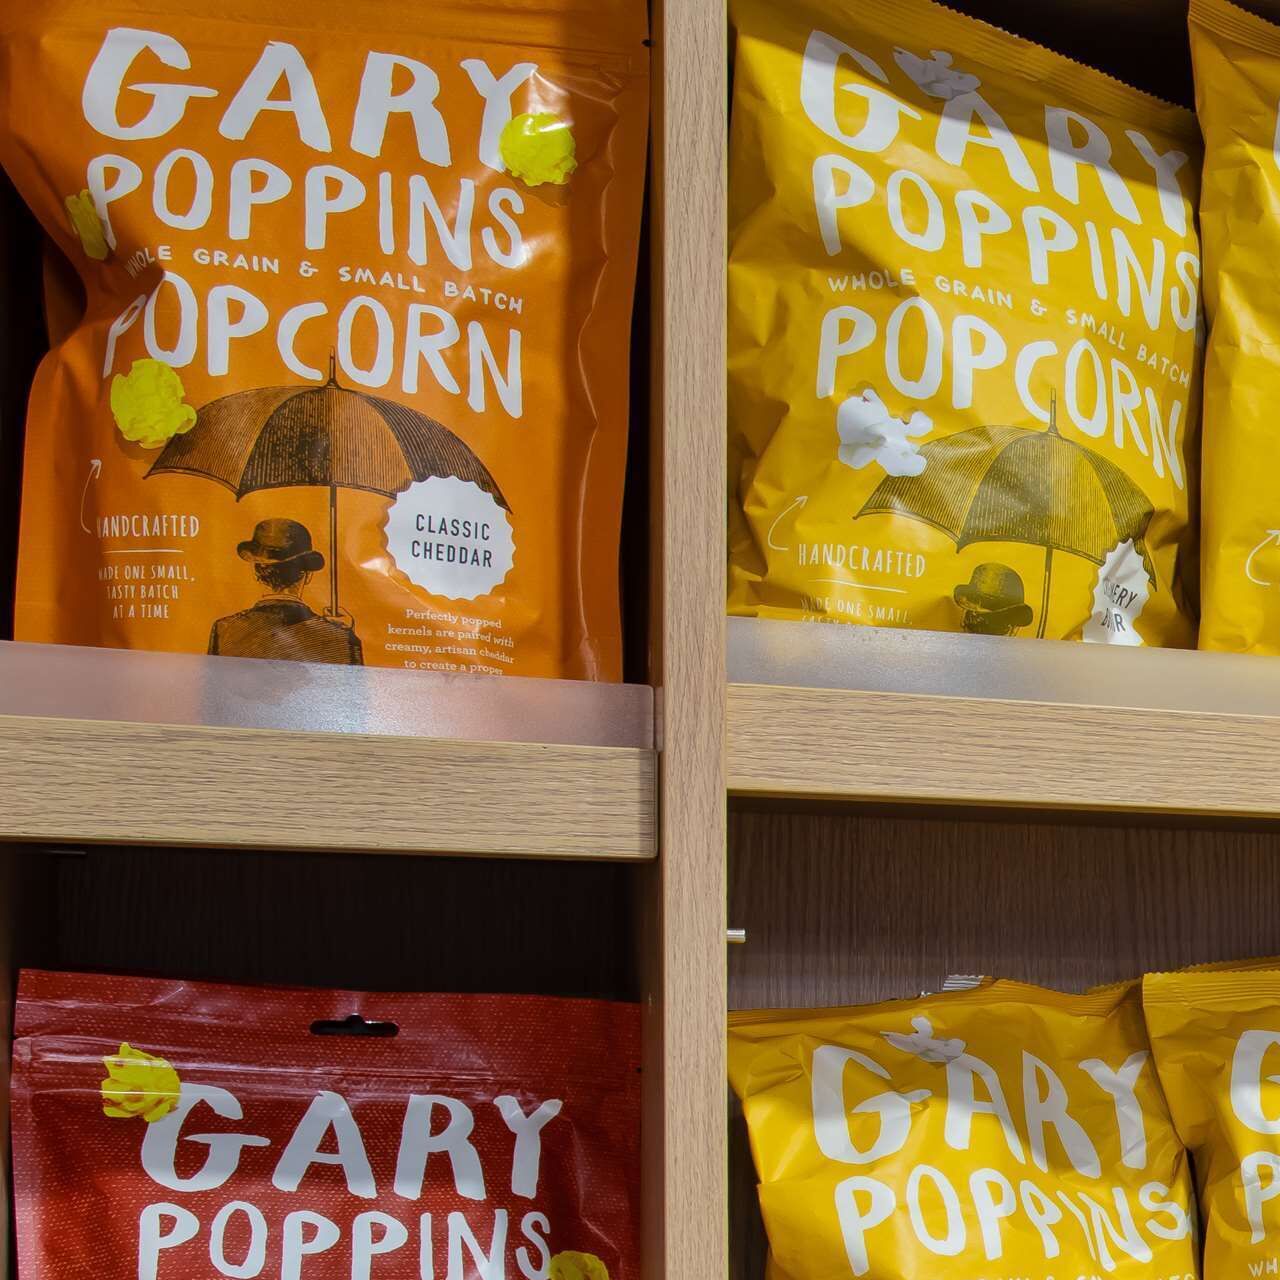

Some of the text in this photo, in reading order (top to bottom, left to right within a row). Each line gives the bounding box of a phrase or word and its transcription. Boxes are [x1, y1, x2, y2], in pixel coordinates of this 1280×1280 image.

[82, 27, 539, 172] GARY
[800, 30, 1189, 238] GARY
[87, 148, 525, 271] POPPINS
[812, 153, 1200, 331] POPPINS
[193, 248, 279, 274] GRAIN
[299, 261, 319, 277] &
[339, 266, 426, 293] SMALL
[444, 280, 523, 315] BATCH
[828, 269, 1190, 387] WHOLE GRAIN & SMALL BATCH
[103, 271, 522, 419] POPCORN
[816, 296, 1184, 490] POPCORN
[125, 564, 145, 580] ONE
[412, 540, 492, 568] CHEDDAR
[416, 514, 490, 541] CLASSIC
[799, 544, 926, 578] HANDCRAFTED
[107, 584, 178, 599] TASTY BATCH
[387, 624, 514, 648] kernels are paired with
[406, 609, 502, 632] Perfectly popped
[385, 642, 515, 664] creamy, artisan cheddar
[141, 1083, 562, 1200] GARY
[812, 1044, 1148, 1179] GARY
[834, 1163, 1186, 1276] POPPINS
